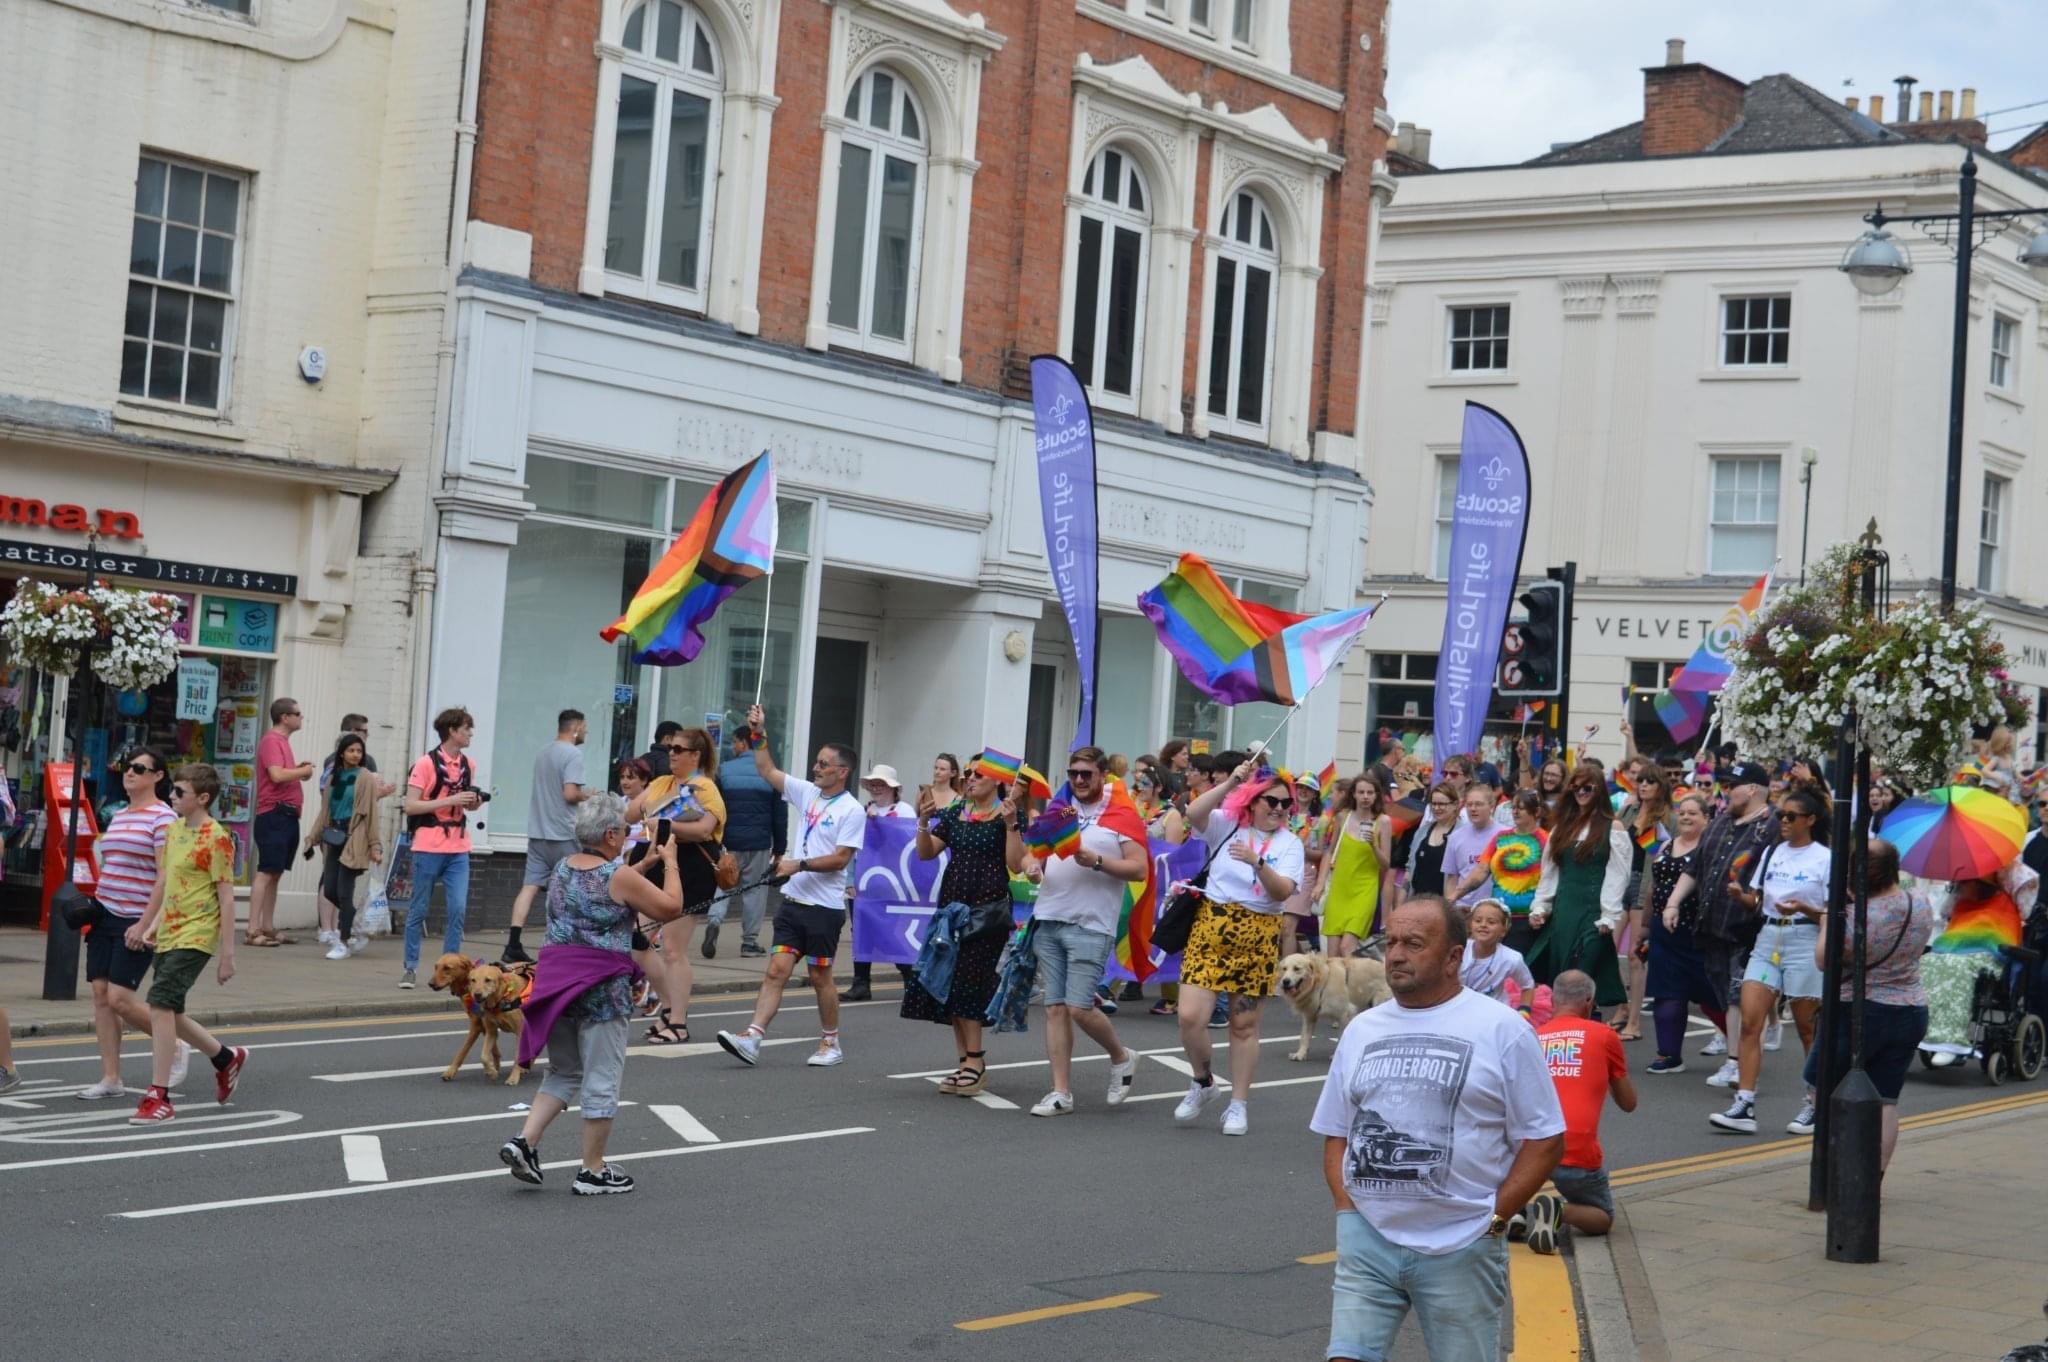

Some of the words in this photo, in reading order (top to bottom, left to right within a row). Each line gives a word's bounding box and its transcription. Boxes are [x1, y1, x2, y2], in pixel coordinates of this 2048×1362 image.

[1596, 617, 1712, 639] VELVET
[200, 630, 233, 645] PRINT
[239, 633, 270, 646] COPY
[184, 699, 208, 716] Price
[1391, 1047, 1426, 1057] VINTAGE
[1355, 1057, 1460, 1088] THUNDERBOLT
